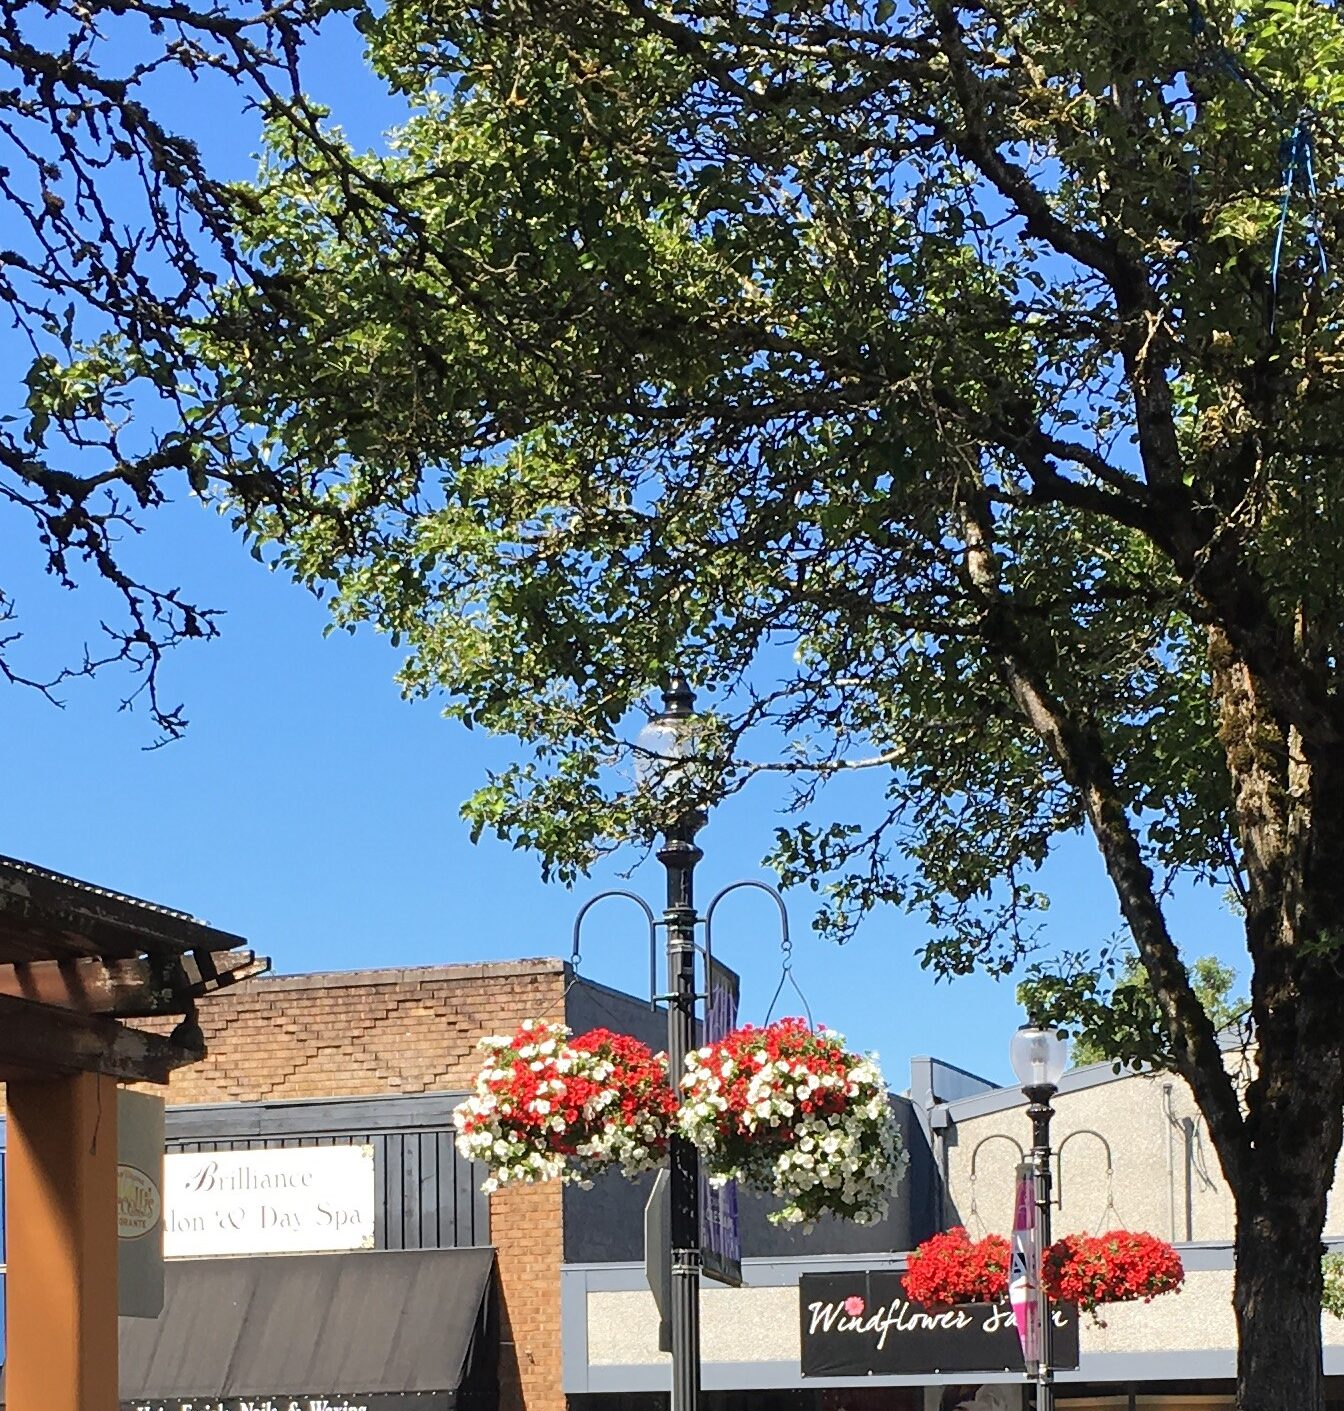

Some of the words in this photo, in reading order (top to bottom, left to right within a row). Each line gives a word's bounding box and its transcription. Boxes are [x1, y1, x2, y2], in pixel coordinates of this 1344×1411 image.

[185, 1161, 313, 1192] Brilliance
[261, 1206, 301, 1232] Day
[316, 1202, 362, 1230] Spa
[808, 1298, 973, 1350] Windflower
[982, 1304, 1069, 1332] San
